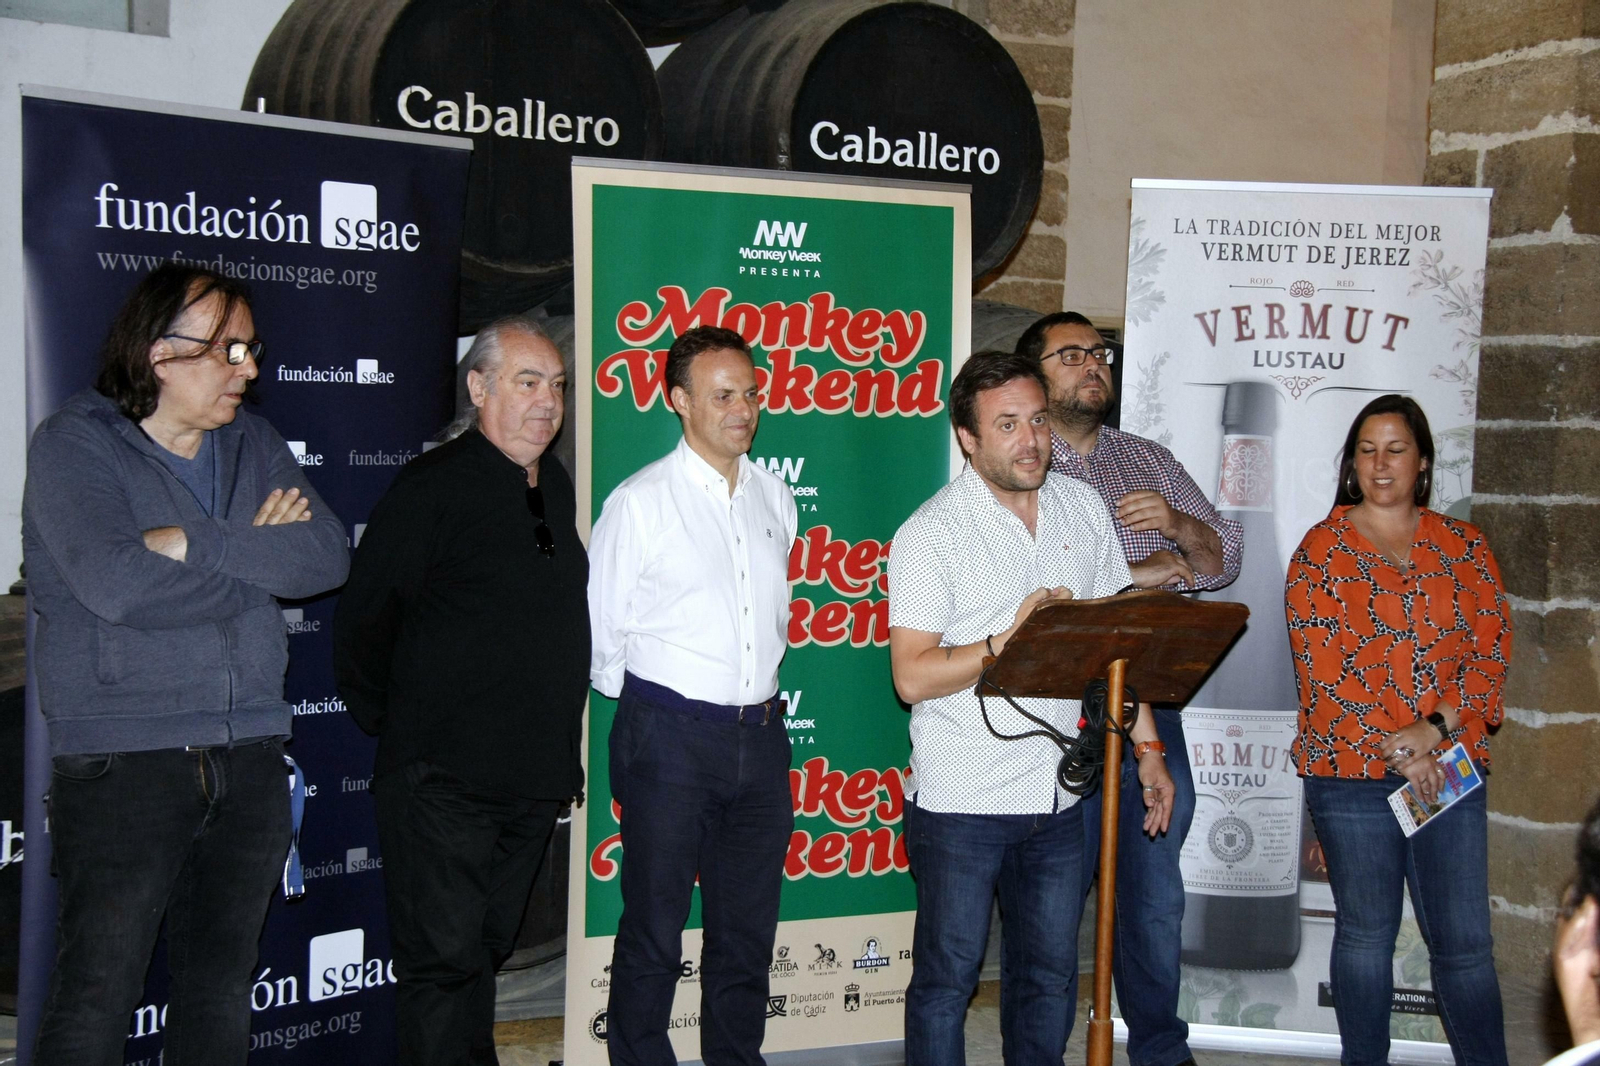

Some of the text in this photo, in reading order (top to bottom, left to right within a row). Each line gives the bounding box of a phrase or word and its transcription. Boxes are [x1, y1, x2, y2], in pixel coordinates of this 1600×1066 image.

[397, 85, 620, 147] Caballero
[809, 120, 1000, 175] Caballero
[95, 183, 421, 252] fundación sgae
[1173, 218, 1442, 246] LA TRADICIÓN DEL MEJOR
[739, 247, 822, 264] Monkey Week
[1201, 242, 1411, 270] VERMUT DE JEREZ
[739, 266, 821, 279] PRESENTA
[1250, 277, 1355, 288] ROJO RED
[615, 285, 927, 369] Monkey
[1194, 303, 1410, 352] VERMUT
[1253, 350, 1345, 371] LUSTAU
[277, 365, 395, 385] fundación sgae
[296, 453, 324, 467] gae
[1191, 742, 1291, 773] ERMUT
[1199, 771, 1267, 788] LUSTAU
[808, 960, 843, 971] MINK
[855, 958, 888, 967] BURDON
[790, 990, 835, 1004] Diputación
[872, 998, 895, 1006] Puerto
[790, 1004, 827, 1017] de Cádiz
